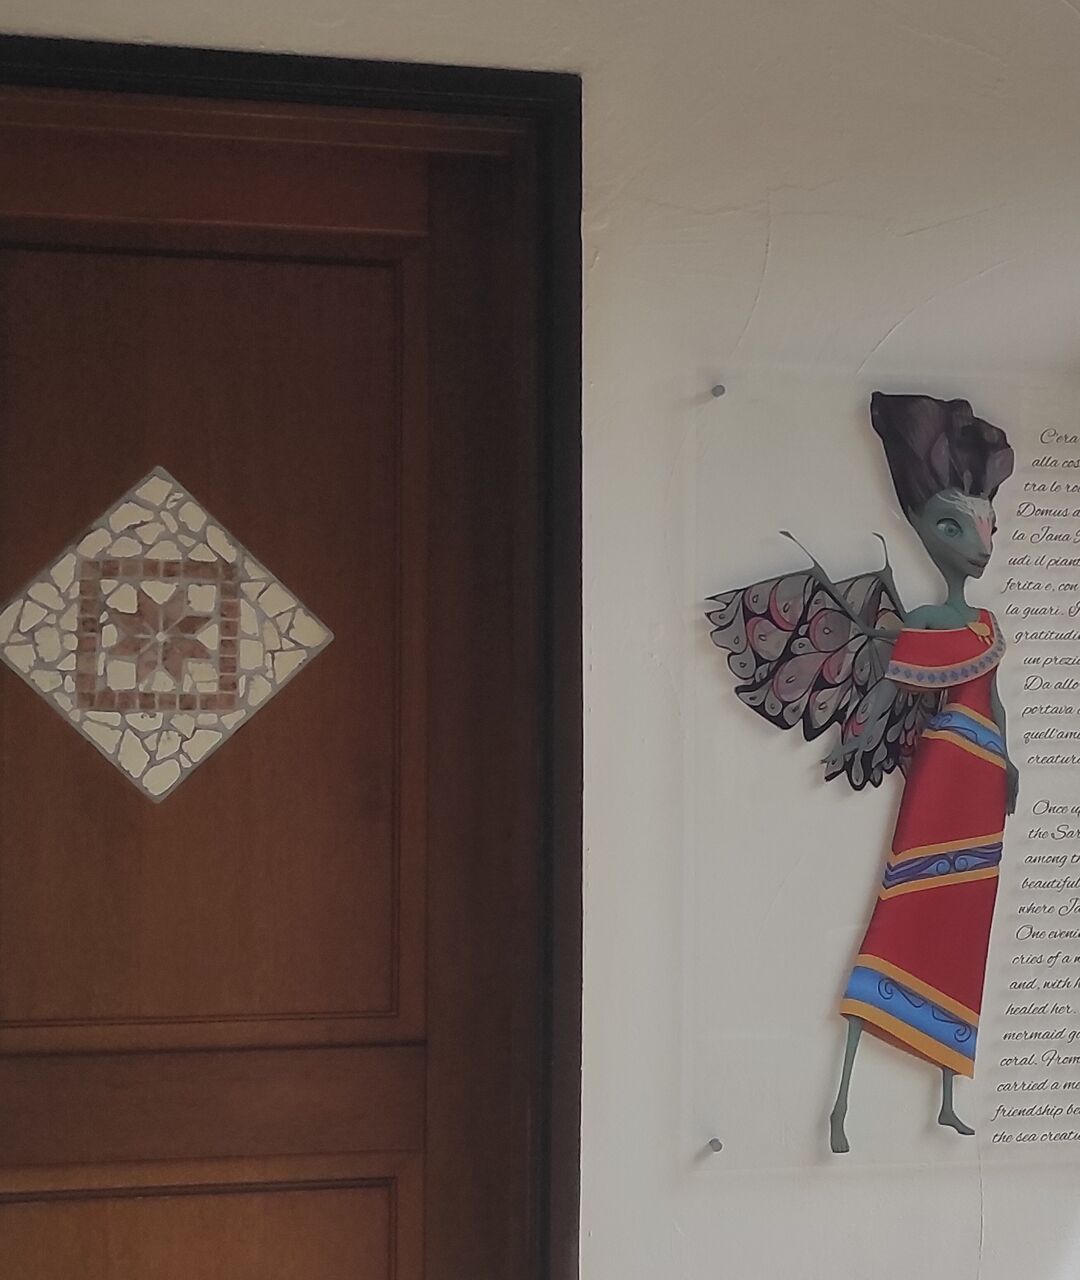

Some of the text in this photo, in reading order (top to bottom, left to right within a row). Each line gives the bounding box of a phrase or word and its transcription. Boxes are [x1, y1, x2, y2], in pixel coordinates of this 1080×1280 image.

[1041, 428, 1078, 444] C'era
[1032, 456, 1058, 467] alla
[1024, 482, 1046, 492] tra
[1050, 481, 1061, 492] le
[1017, 502, 1068, 517] Domus
[1012, 530, 1026, 540] la
[1030, 526, 1071, 543] Jana
[1034, 555, 1046, 566] il
[1000, 578, 1041, 594] ferita
[1058, 583, 1078, 591] con
[1006, 604, 1020, 615] la
[1023, 656, 1041, 665] un
[1024, 675, 1052, 691] Da
[1022, 705, 1073, 717] portava
[1033, 800, 1068, 815] Once
[1028, 828, 1048, 839] the
[1025, 854, 1067, 867] among
[1022, 877, 1080, 893] beautiful
[1019, 903, 1056, 914] where
[1016, 925, 1046, 941] One
[1012, 954, 1043, 965] cries
[1047, 951, 1062, 968] of
[1043, 978, 1072, 989] with
[1005, 1003, 1047, 1015] healed
[1003, 1028, 1066, 1041] mermaid
[997, 1079, 1048, 1092] carried
[1050, 1082, 1060, 1090] a
[991, 1104, 1064, 1122] friendship
[992, 1131, 1013, 1143] the
[1016, 1132, 1038, 1142] sea
